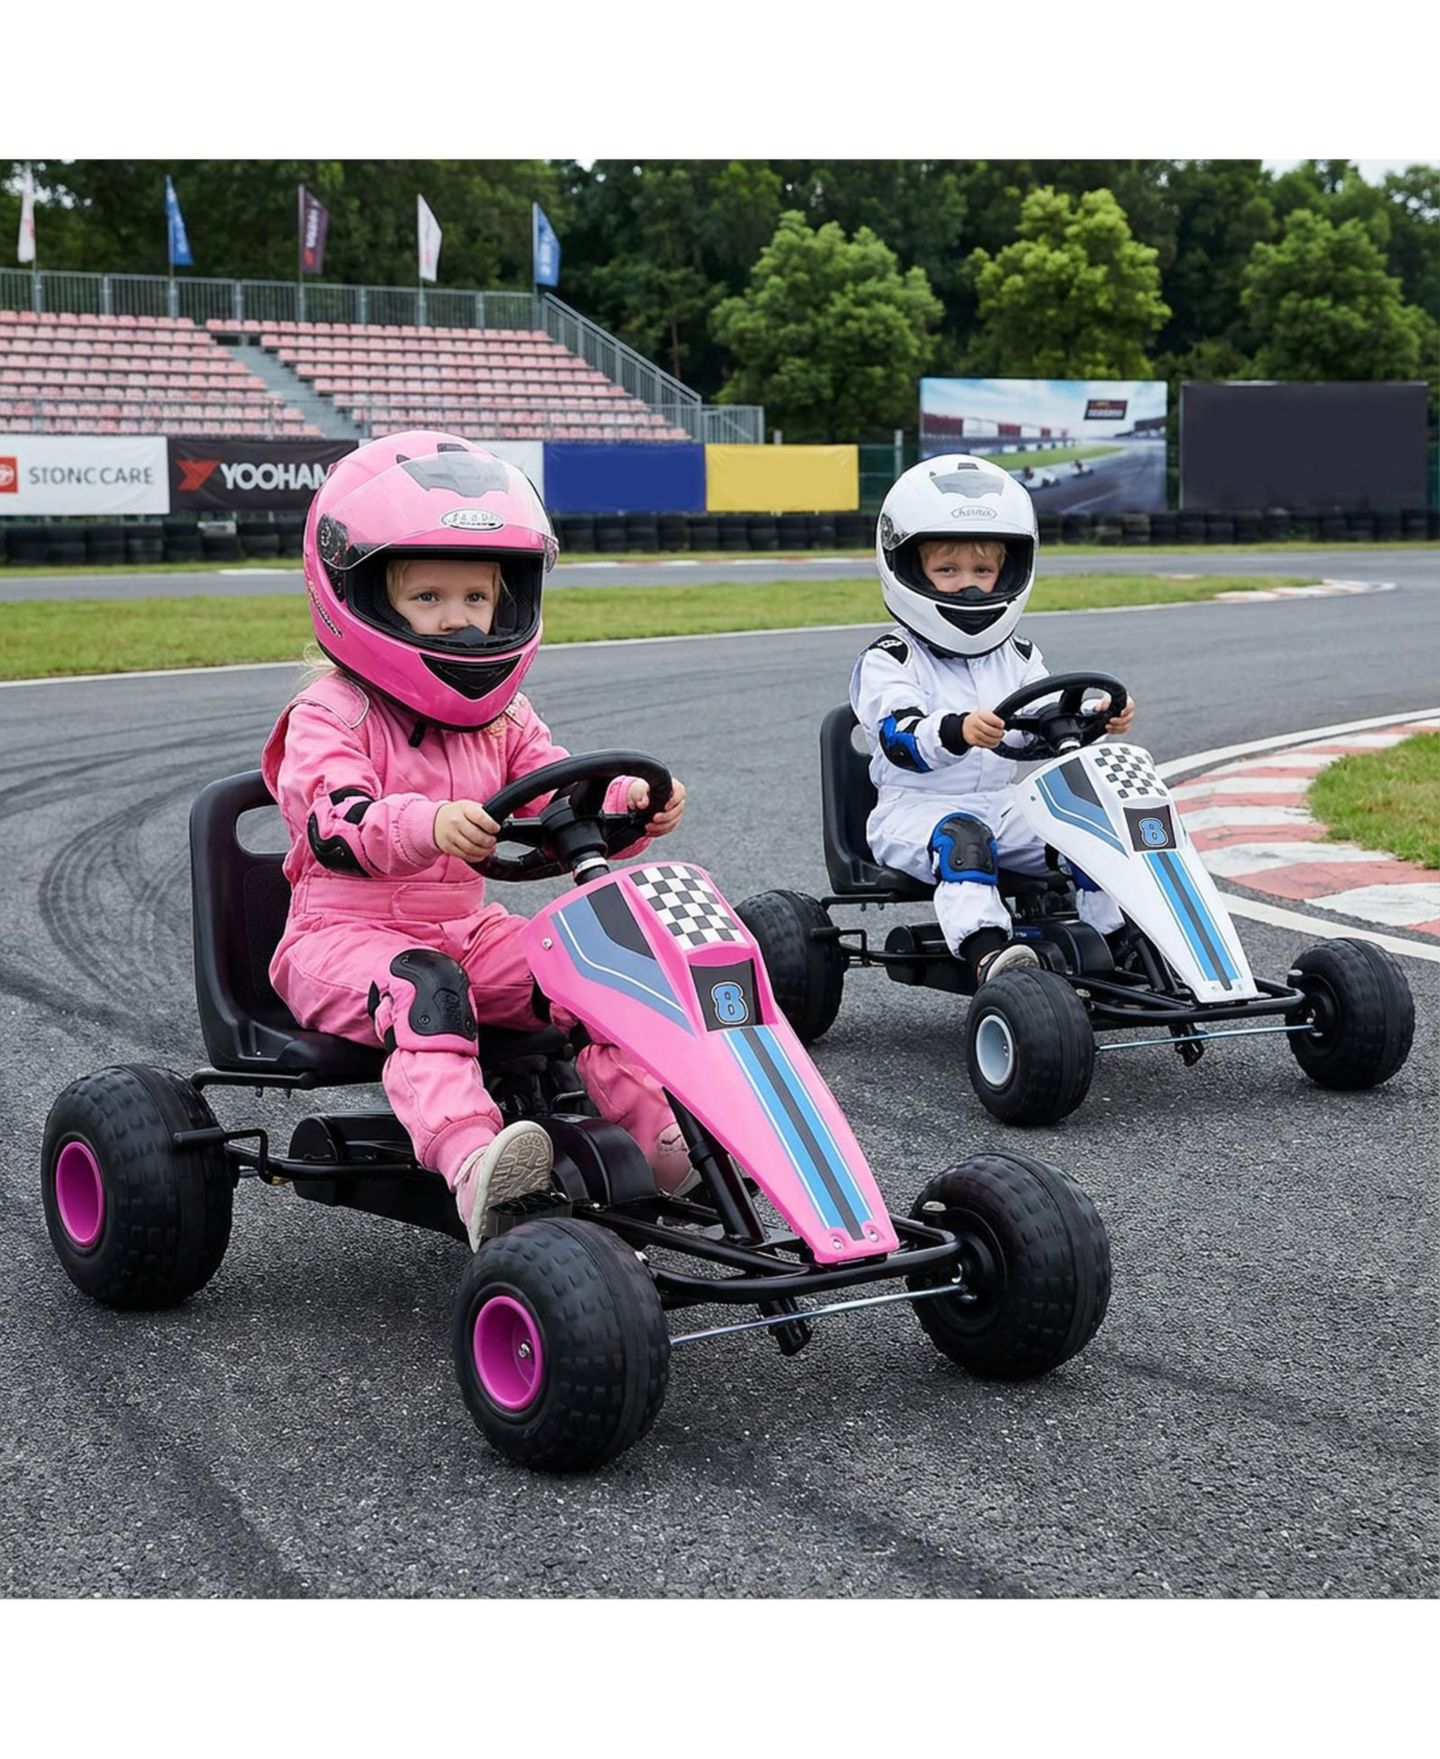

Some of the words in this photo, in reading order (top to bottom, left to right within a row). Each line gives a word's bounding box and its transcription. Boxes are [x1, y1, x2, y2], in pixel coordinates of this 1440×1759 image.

[99, 466, 155, 485] CARE
[1138, 817, 1169, 848] 8
[710, 981, 749, 1025] 8
